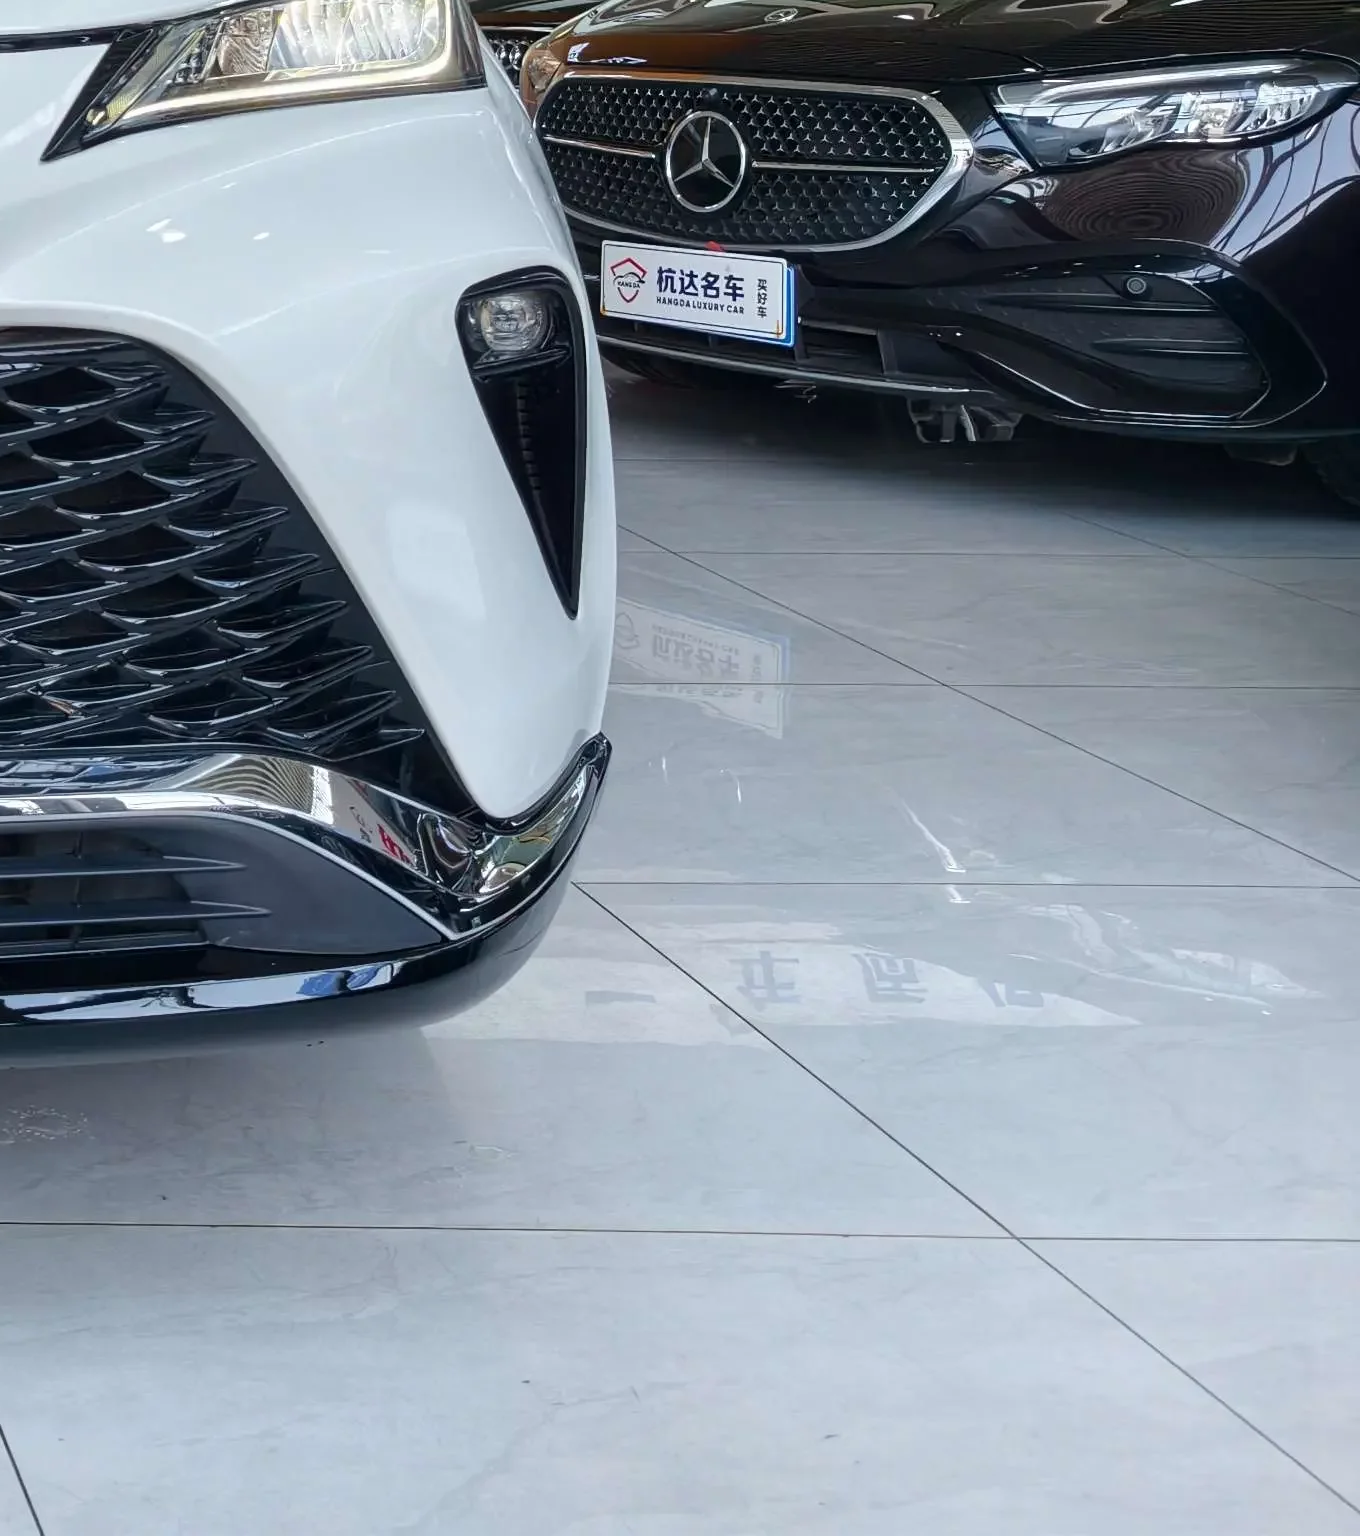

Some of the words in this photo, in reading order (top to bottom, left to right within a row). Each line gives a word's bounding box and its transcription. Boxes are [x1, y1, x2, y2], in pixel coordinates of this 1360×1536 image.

[656, 265, 745, 302] 杭达名车
[656, 295, 691, 308] HANGDA
[692, 300, 724, 312] LUXURY
[726, 304, 745, 315] CAR
